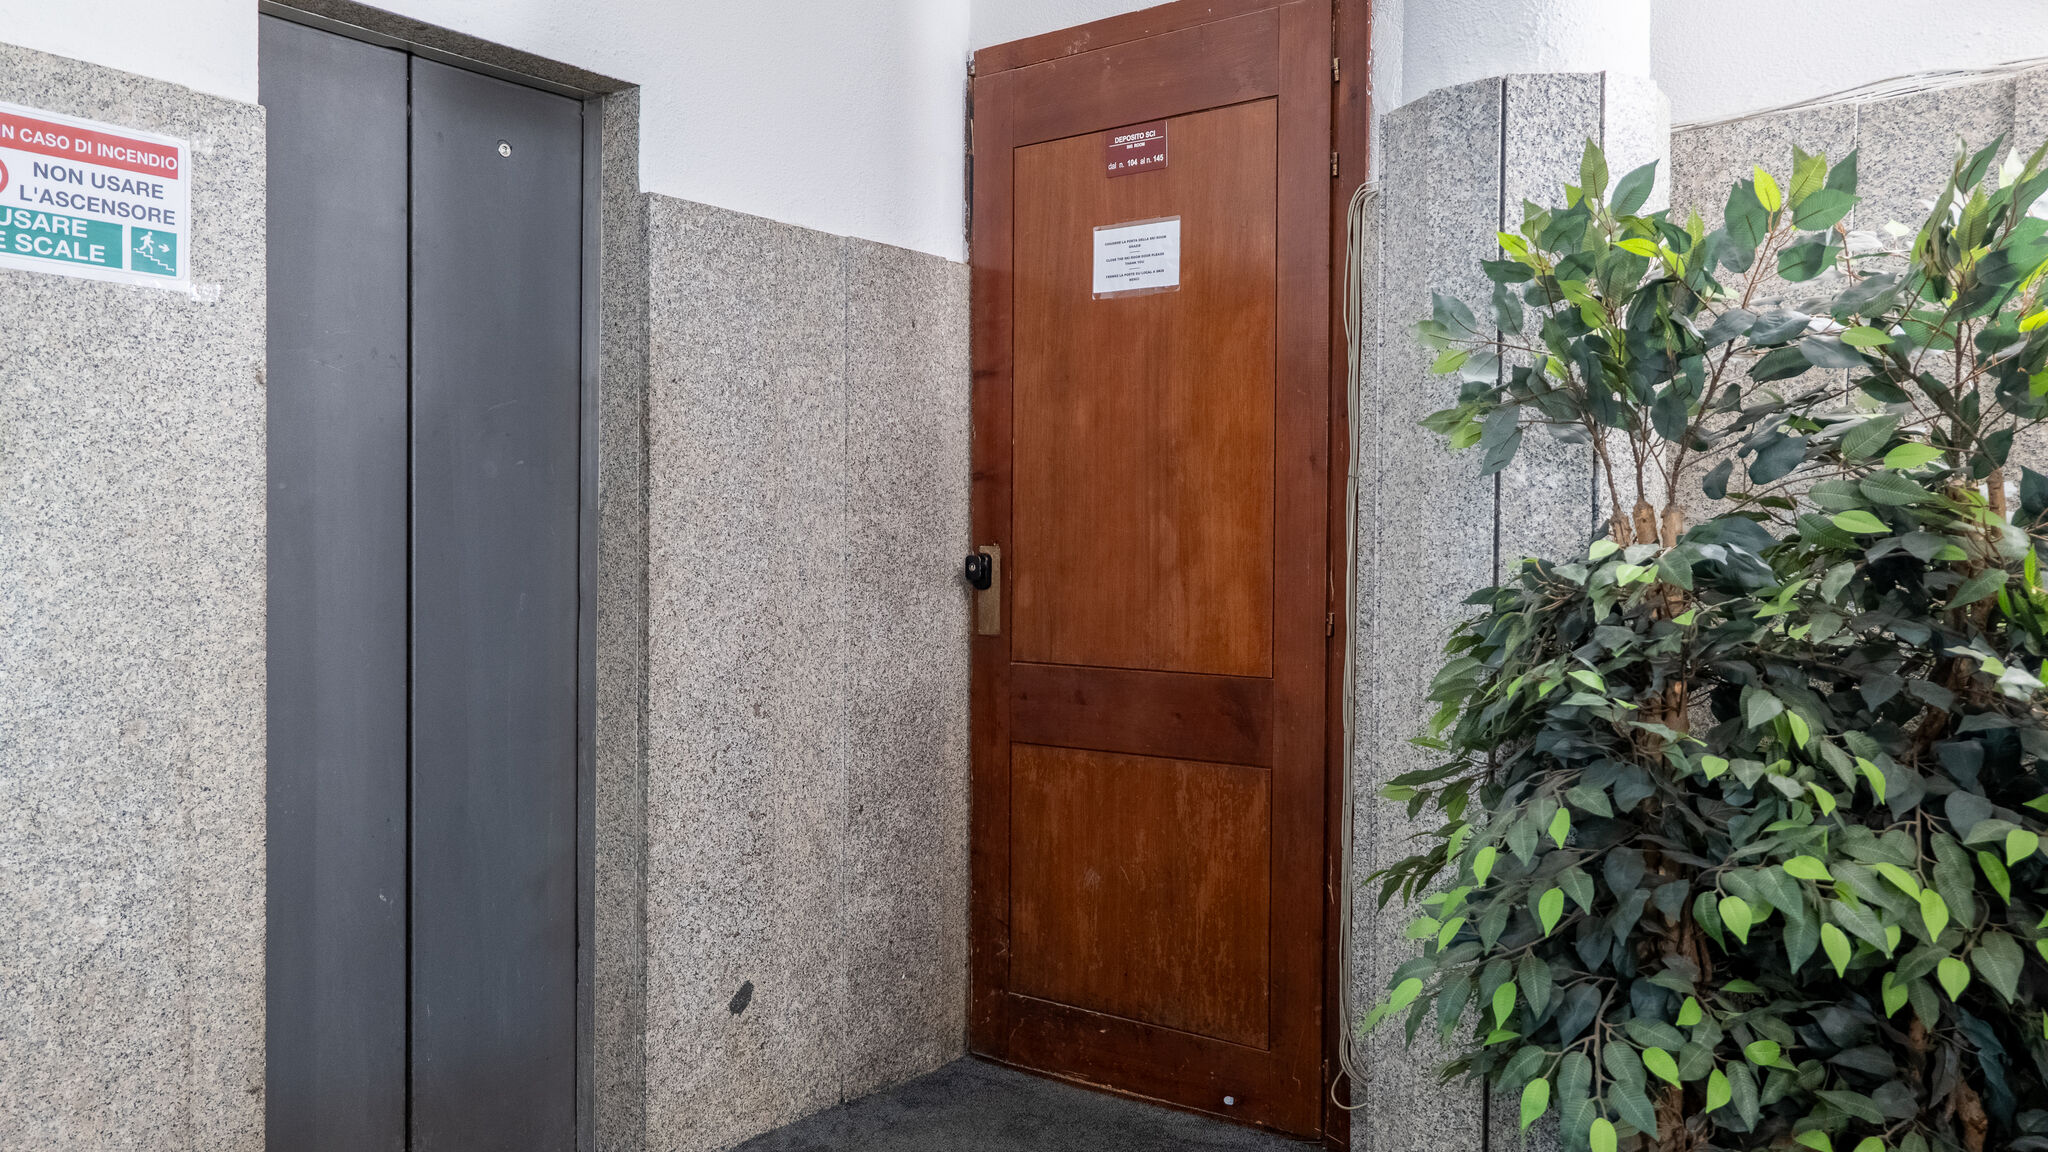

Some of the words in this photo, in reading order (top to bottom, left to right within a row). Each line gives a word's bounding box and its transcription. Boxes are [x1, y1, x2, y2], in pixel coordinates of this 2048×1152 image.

[19, 128, 70, 150] CASO
[75, 139, 92, 154] DI
[97, 143, 178, 171] INCENDIO
[1114, 132, 1145, 144] DEPOSITO
[1145, 130, 1156, 138] SCI
[33, 161, 84, 186] NON
[91, 172, 164, 200] USARE
[19, 184, 176, 226] L'ASCENSORE
[0, 208, 88, 239] USARE
[15, 232, 106, 263] SCALE
